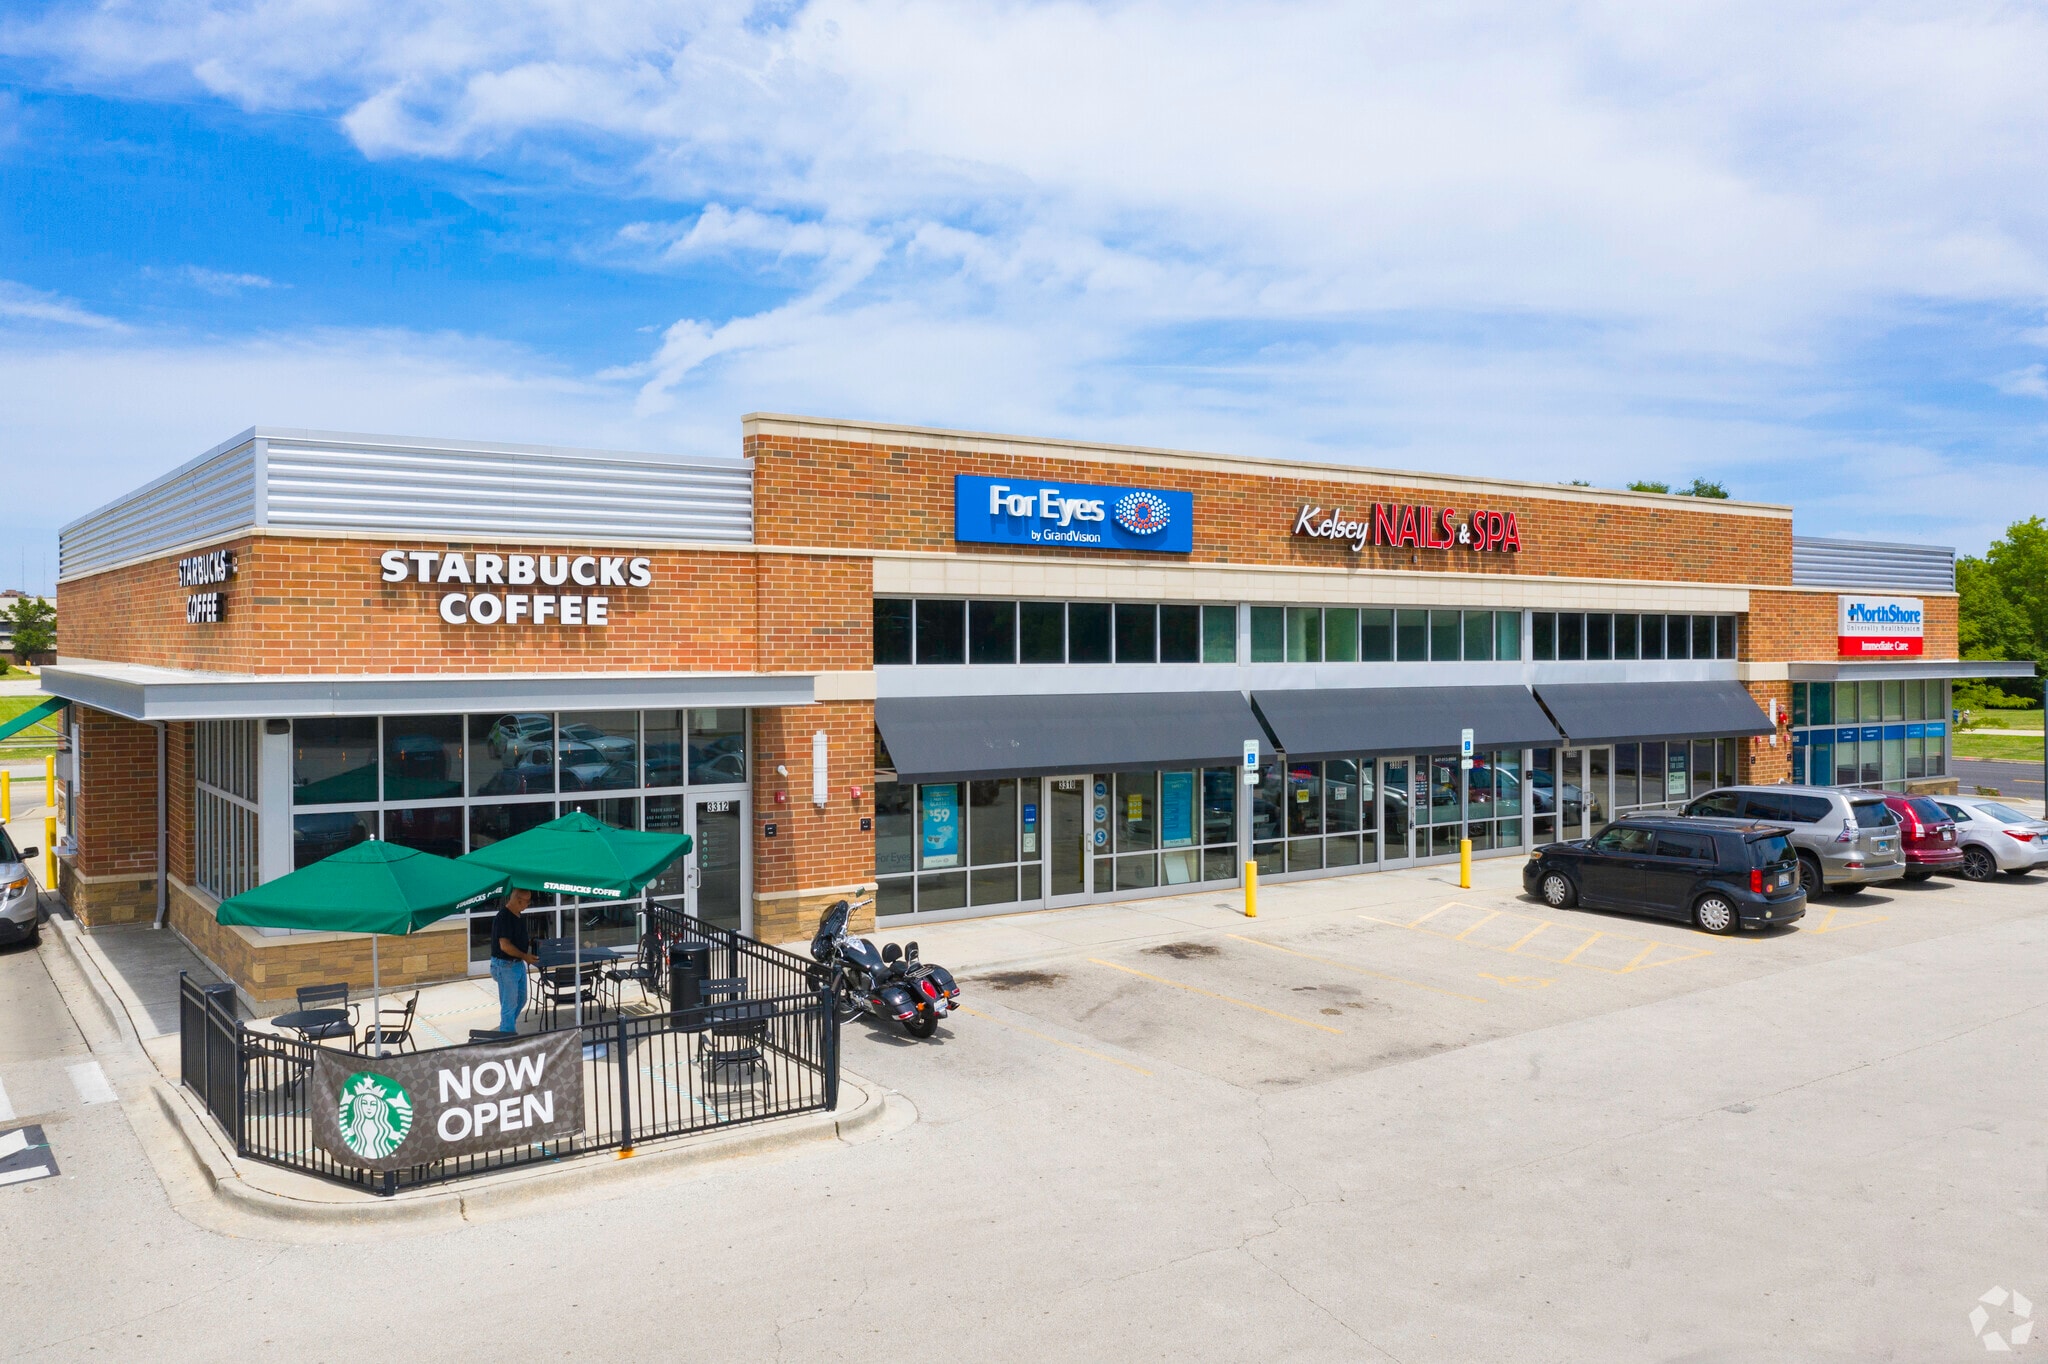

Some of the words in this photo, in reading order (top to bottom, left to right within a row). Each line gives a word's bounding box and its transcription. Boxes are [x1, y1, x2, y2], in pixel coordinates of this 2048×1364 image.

[989, 484, 1038, 517] For
[1039, 488, 1105, 527] Eyes
[1031, 529, 1041, 542] by
[1043, 528, 1101, 543] GrandVision
[1293, 503, 1369, 552] Kelsey
[1374, 502, 1457, 549] NAILS
[1458, 522, 1470, 545] &
[1472, 509, 1522, 553] SPA
[178, 549, 227, 588] STARBUCKS
[380, 549, 652, 588] STARBUCKS
[187, 592, 218, 624] COFFEE
[439, 592, 609, 626] COFFEE
[1856, 603, 1921, 623] NorthShore
[1861, 641, 1894, 651] Immediate
[1894, 641, 1909, 651] Care
[1059, 780, 1076, 789] 3310
[707, 801, 729, 812] 3312
[929, 808, 951, 823] $59
[543, 881, 592, 894] STARBUCKS
[592, 887, 622, 897] COFFEE
[438, 1052, 547, 1104] NOW
[437, 1090, 554, 1142] OPEN
